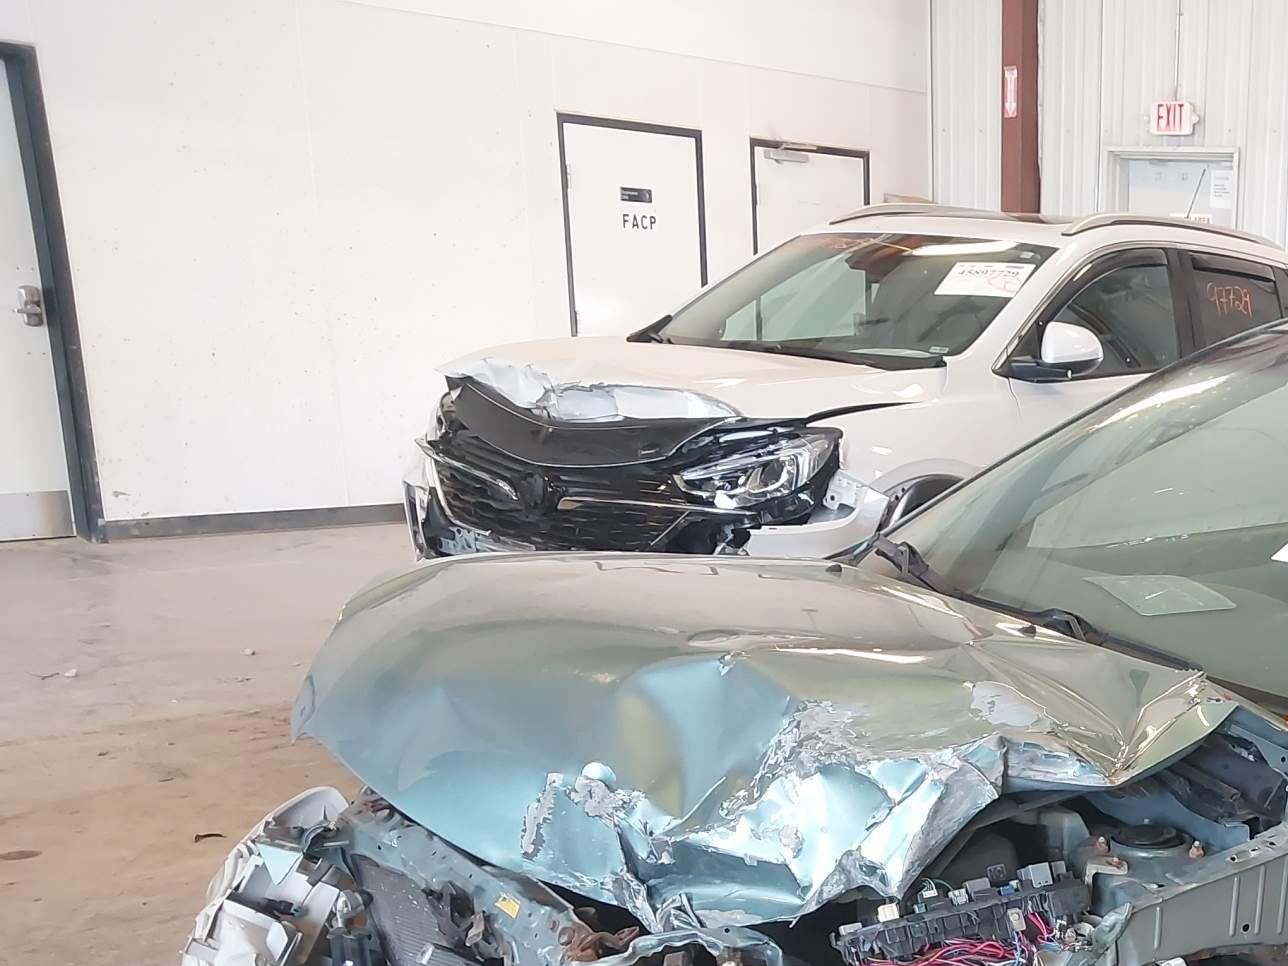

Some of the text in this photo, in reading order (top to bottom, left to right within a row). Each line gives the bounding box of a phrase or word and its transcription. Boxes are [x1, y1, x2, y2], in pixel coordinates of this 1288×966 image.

[1156, 103, 1185, 131] EXIT
[622, 213, 657, 230] FACP
[1207, 282, 1252, 317] 97729
